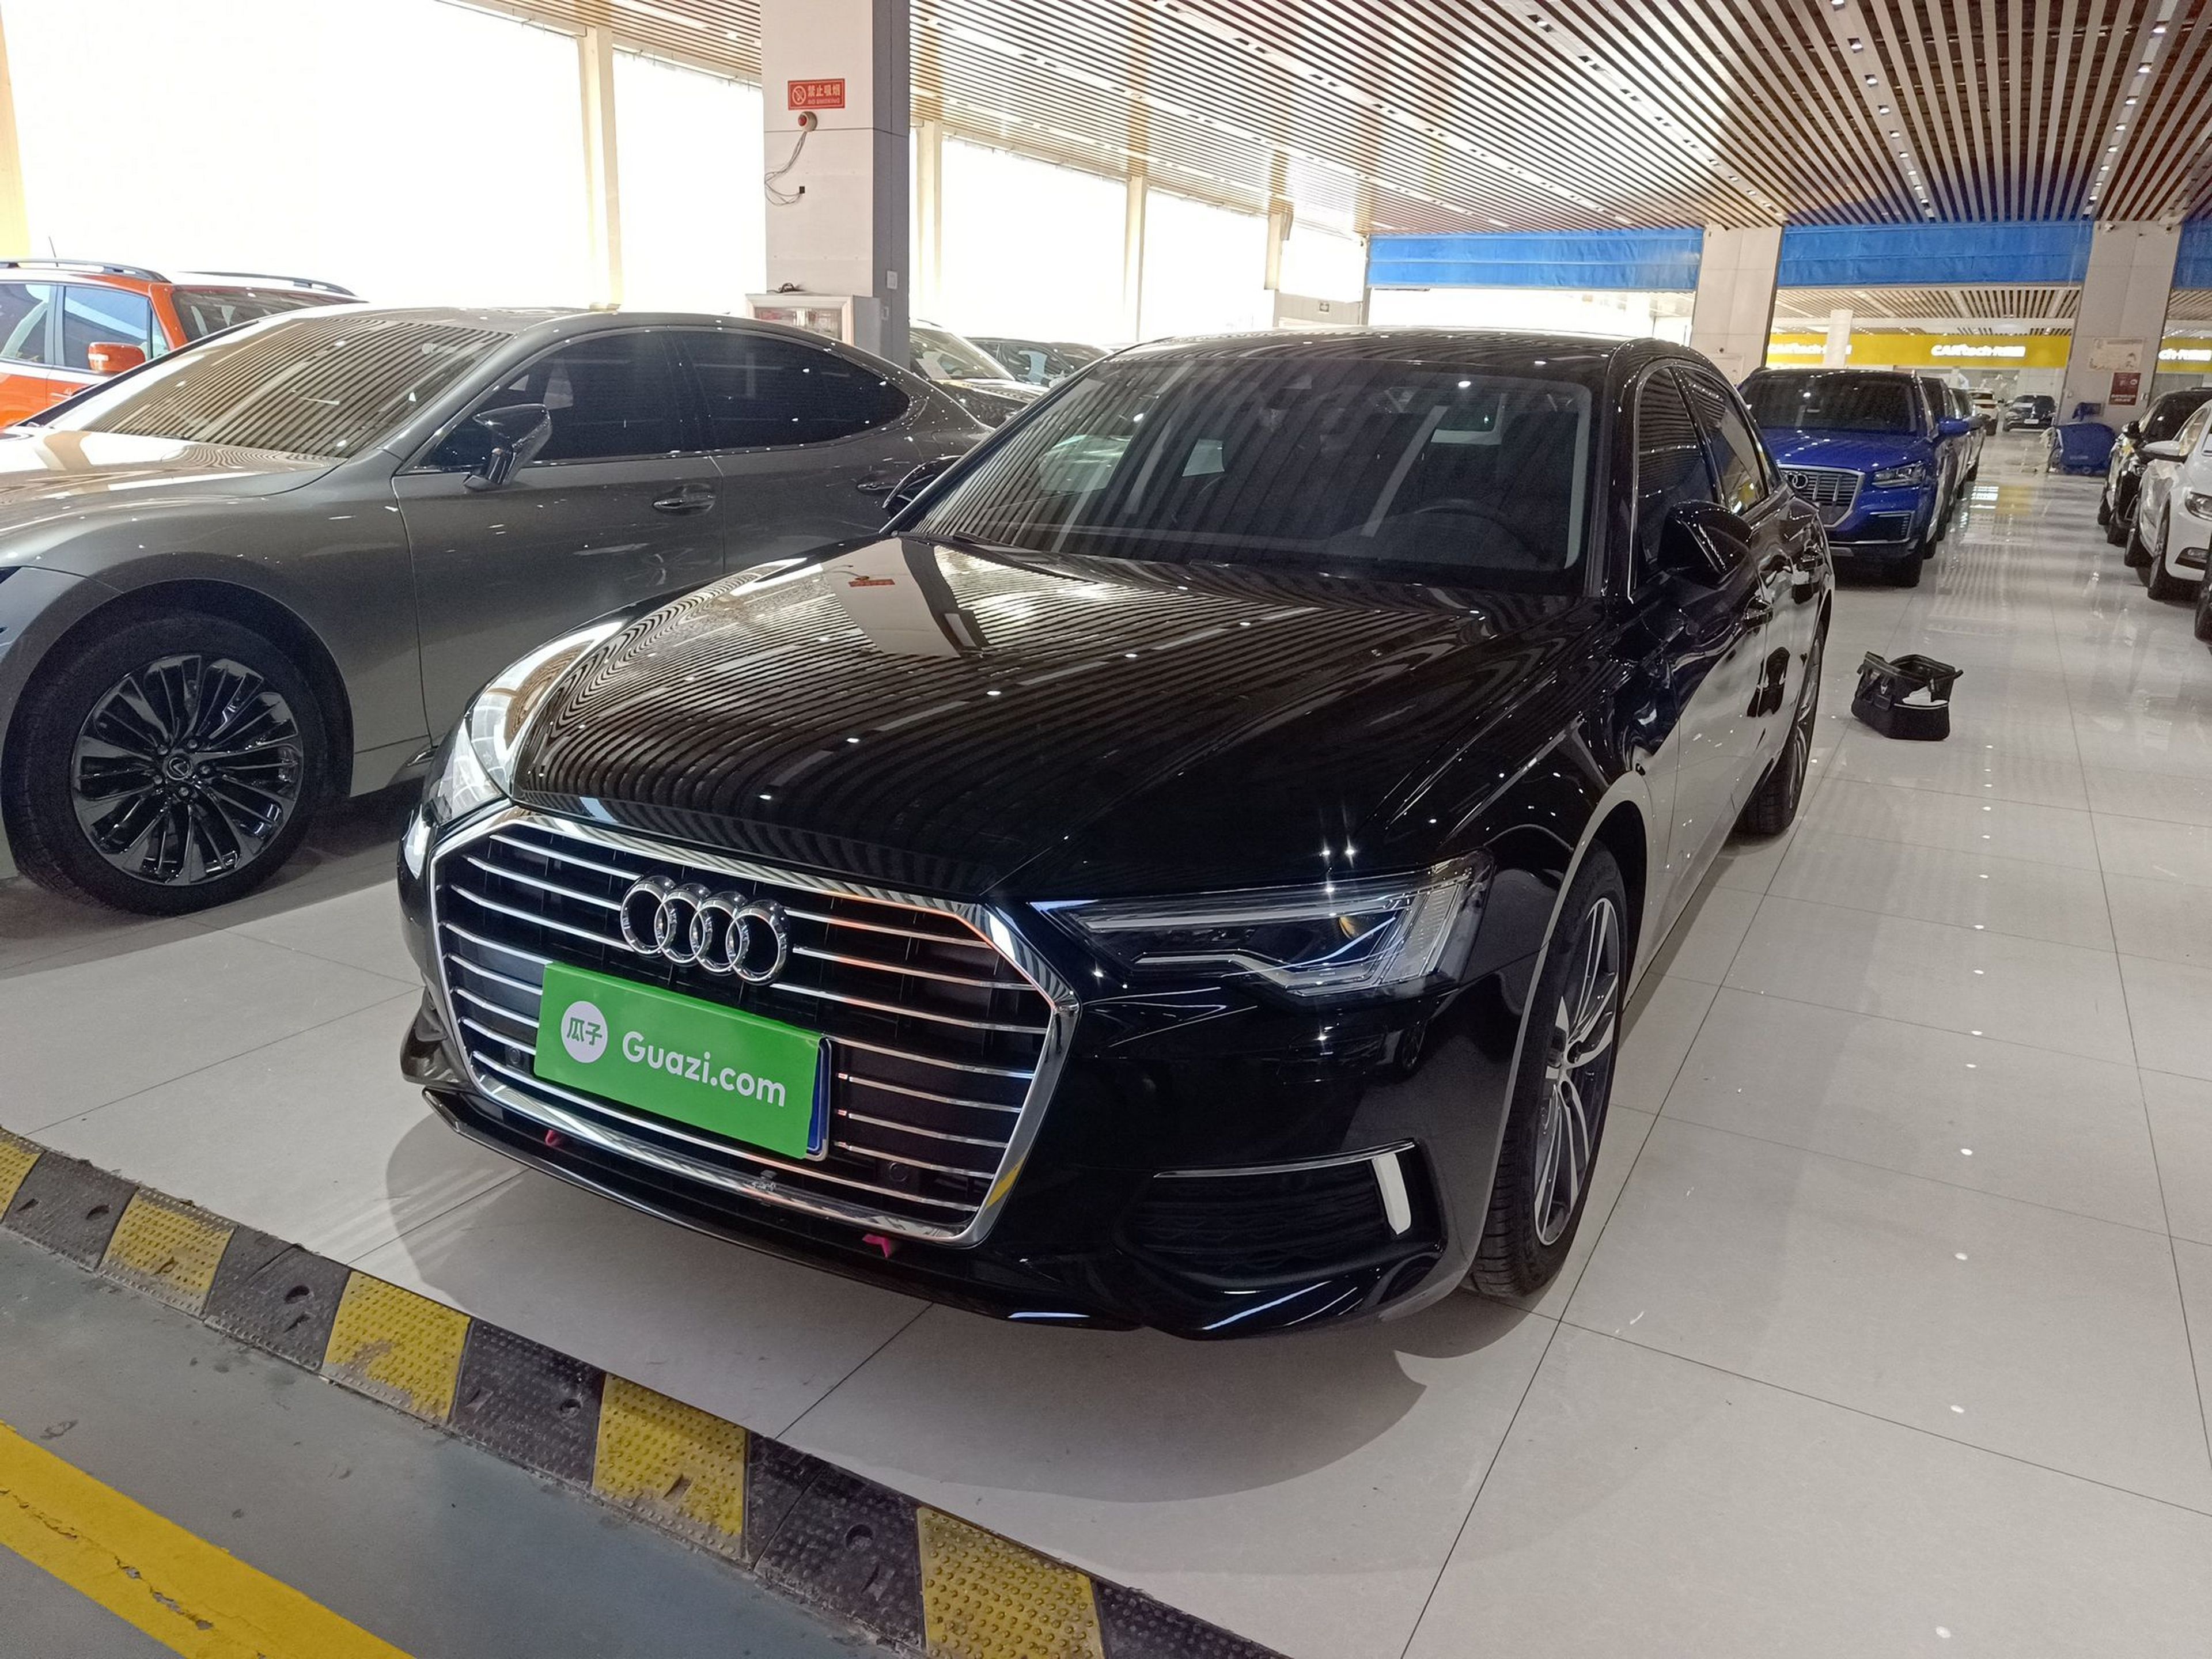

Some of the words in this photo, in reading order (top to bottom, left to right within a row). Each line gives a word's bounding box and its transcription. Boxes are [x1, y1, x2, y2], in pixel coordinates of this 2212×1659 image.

[808, 84, 840, 97] 禁止吸烟
[567, 1017, 603, 1046] 瓜子
[622, 1031, 786, 1107] Guazi.com
